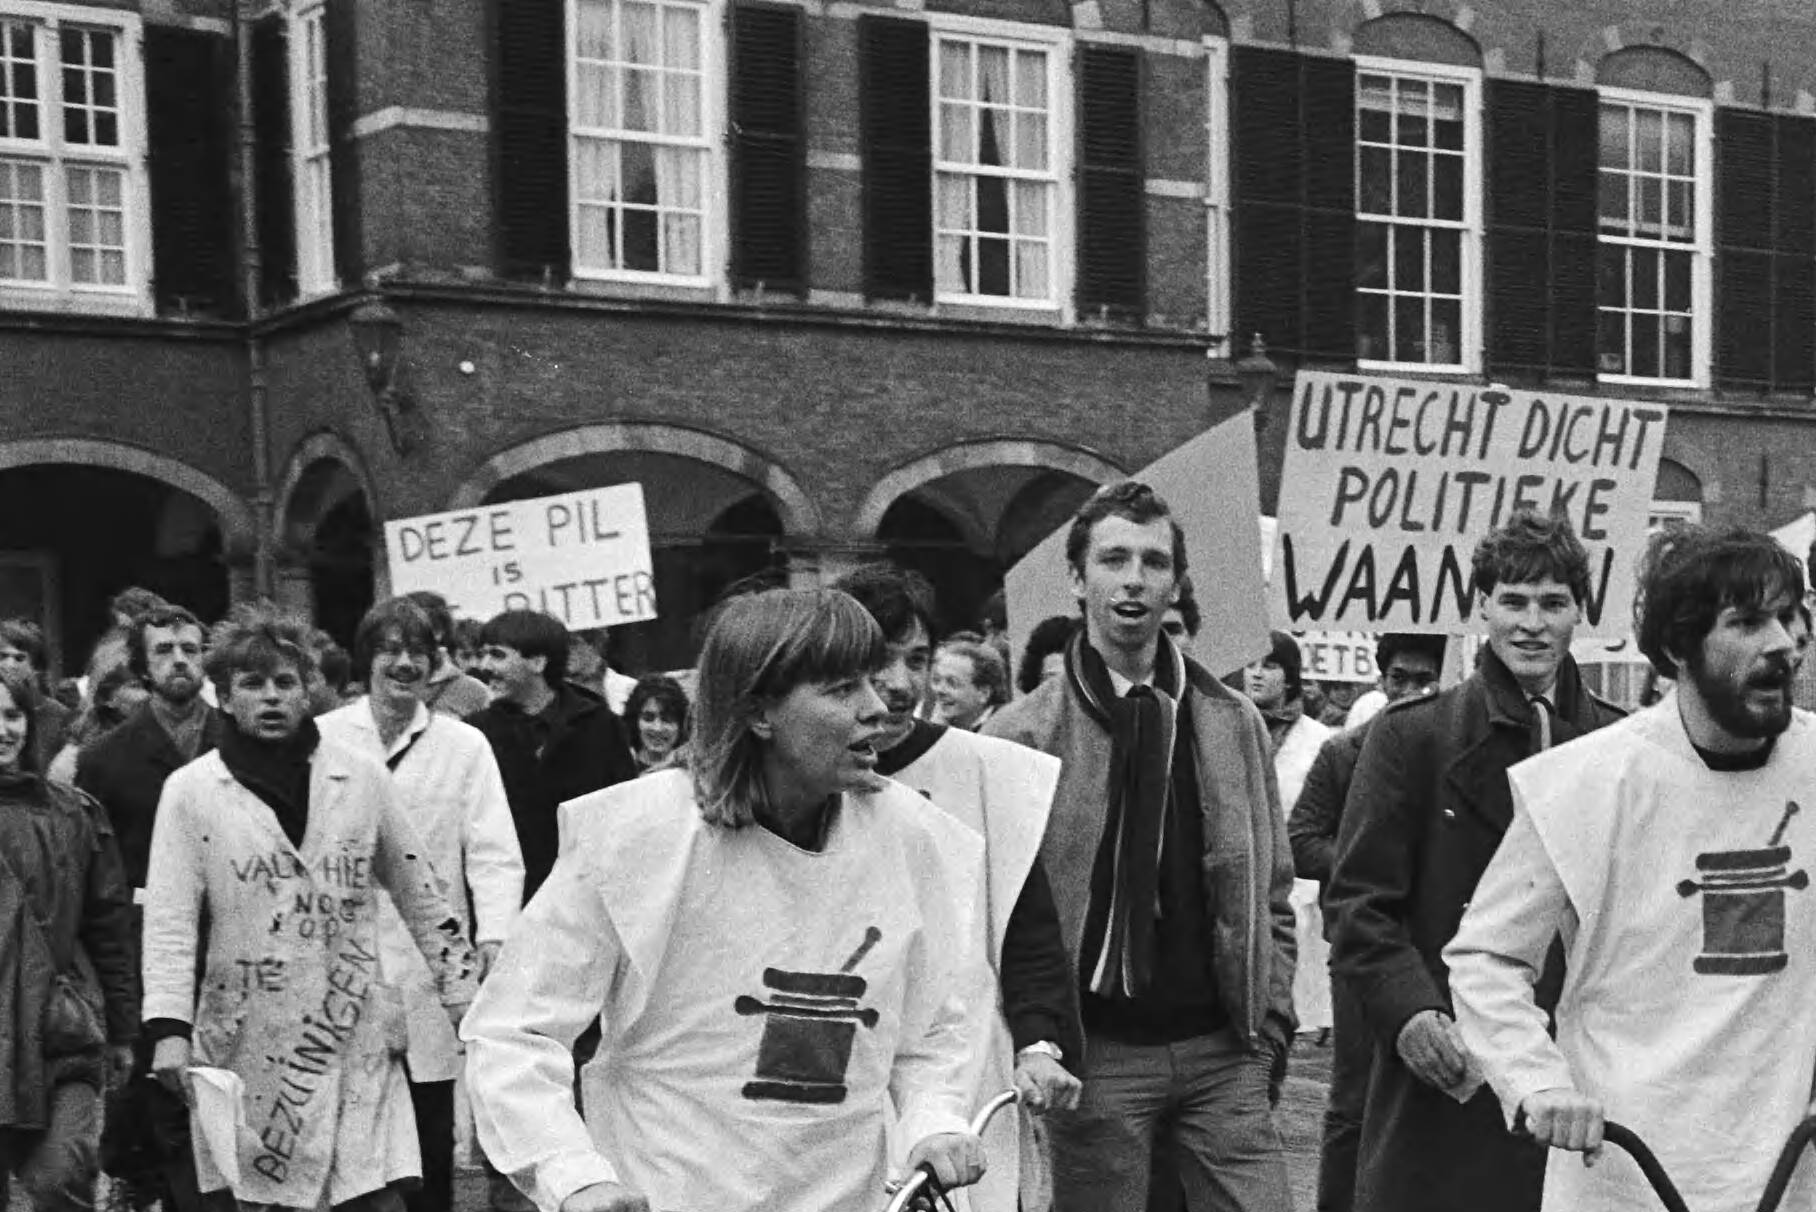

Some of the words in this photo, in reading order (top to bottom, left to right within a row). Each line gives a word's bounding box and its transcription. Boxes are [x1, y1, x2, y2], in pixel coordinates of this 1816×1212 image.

[1295, 380, 1511, 460] UTRECHT
[1517, 399, 1664, 470] DICHT
[399, 510, 515, 563] DEZE
[546, 499, 620, 547] PIL
[1330, 466, 1617, 540] POLITIEKE
[492, 562, 523, 586] IS
[1283, 532, 1615, 627] WAANN
